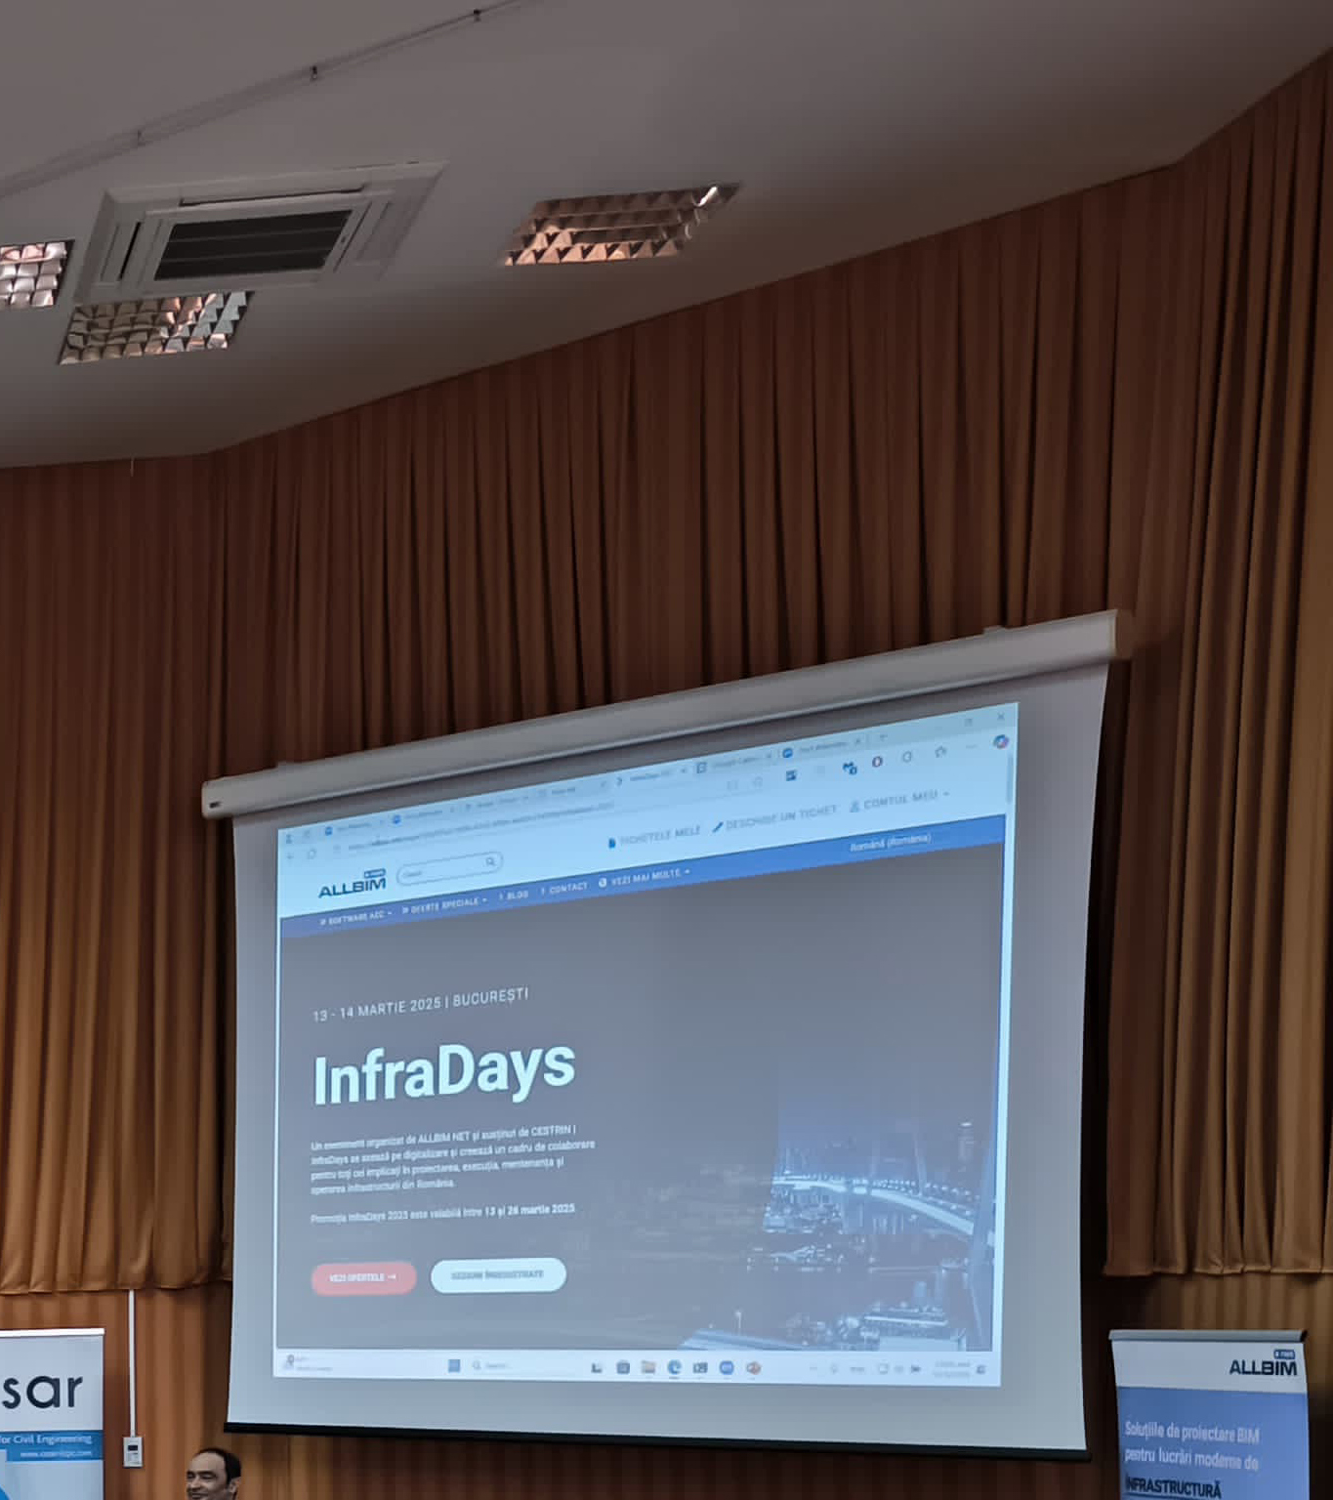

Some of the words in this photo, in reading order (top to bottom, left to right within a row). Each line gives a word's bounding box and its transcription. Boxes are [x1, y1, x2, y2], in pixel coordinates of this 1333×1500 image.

[318, 877, 387, 899] ALLBIM
[548, 881, 588, 895] CONTACT
[313, 1011, 328, 1023] 13
[339, 1007, 354, 1020] 14
[357, 1001, 407, 1018] MARTIE
[410, 996, 442, 1013] 2025
[452, 986, 529, 1008] BUCUREȘTI
[314, 1043, 576, 1105] InfraDays
[531, 1124, 572, 1137] CESTRIN
[507, 1142, 533, 1154] cadru
[534, 1141, 546, 1152] de
[520, 1204, 551, 1216] martie
[551, 1203, 576, 1214] 2025
[1229, 1360, 1298, 1376] ALLBIM
[13, 1432, 35, 1446] Civil
[37, 1433, 93, 1447] Engineering
[1166, 1422, 1180, 1439] de
[1181, 1424, 1234, 1443] proiectare
[1236, 1427, 1261, 1445] BIM
